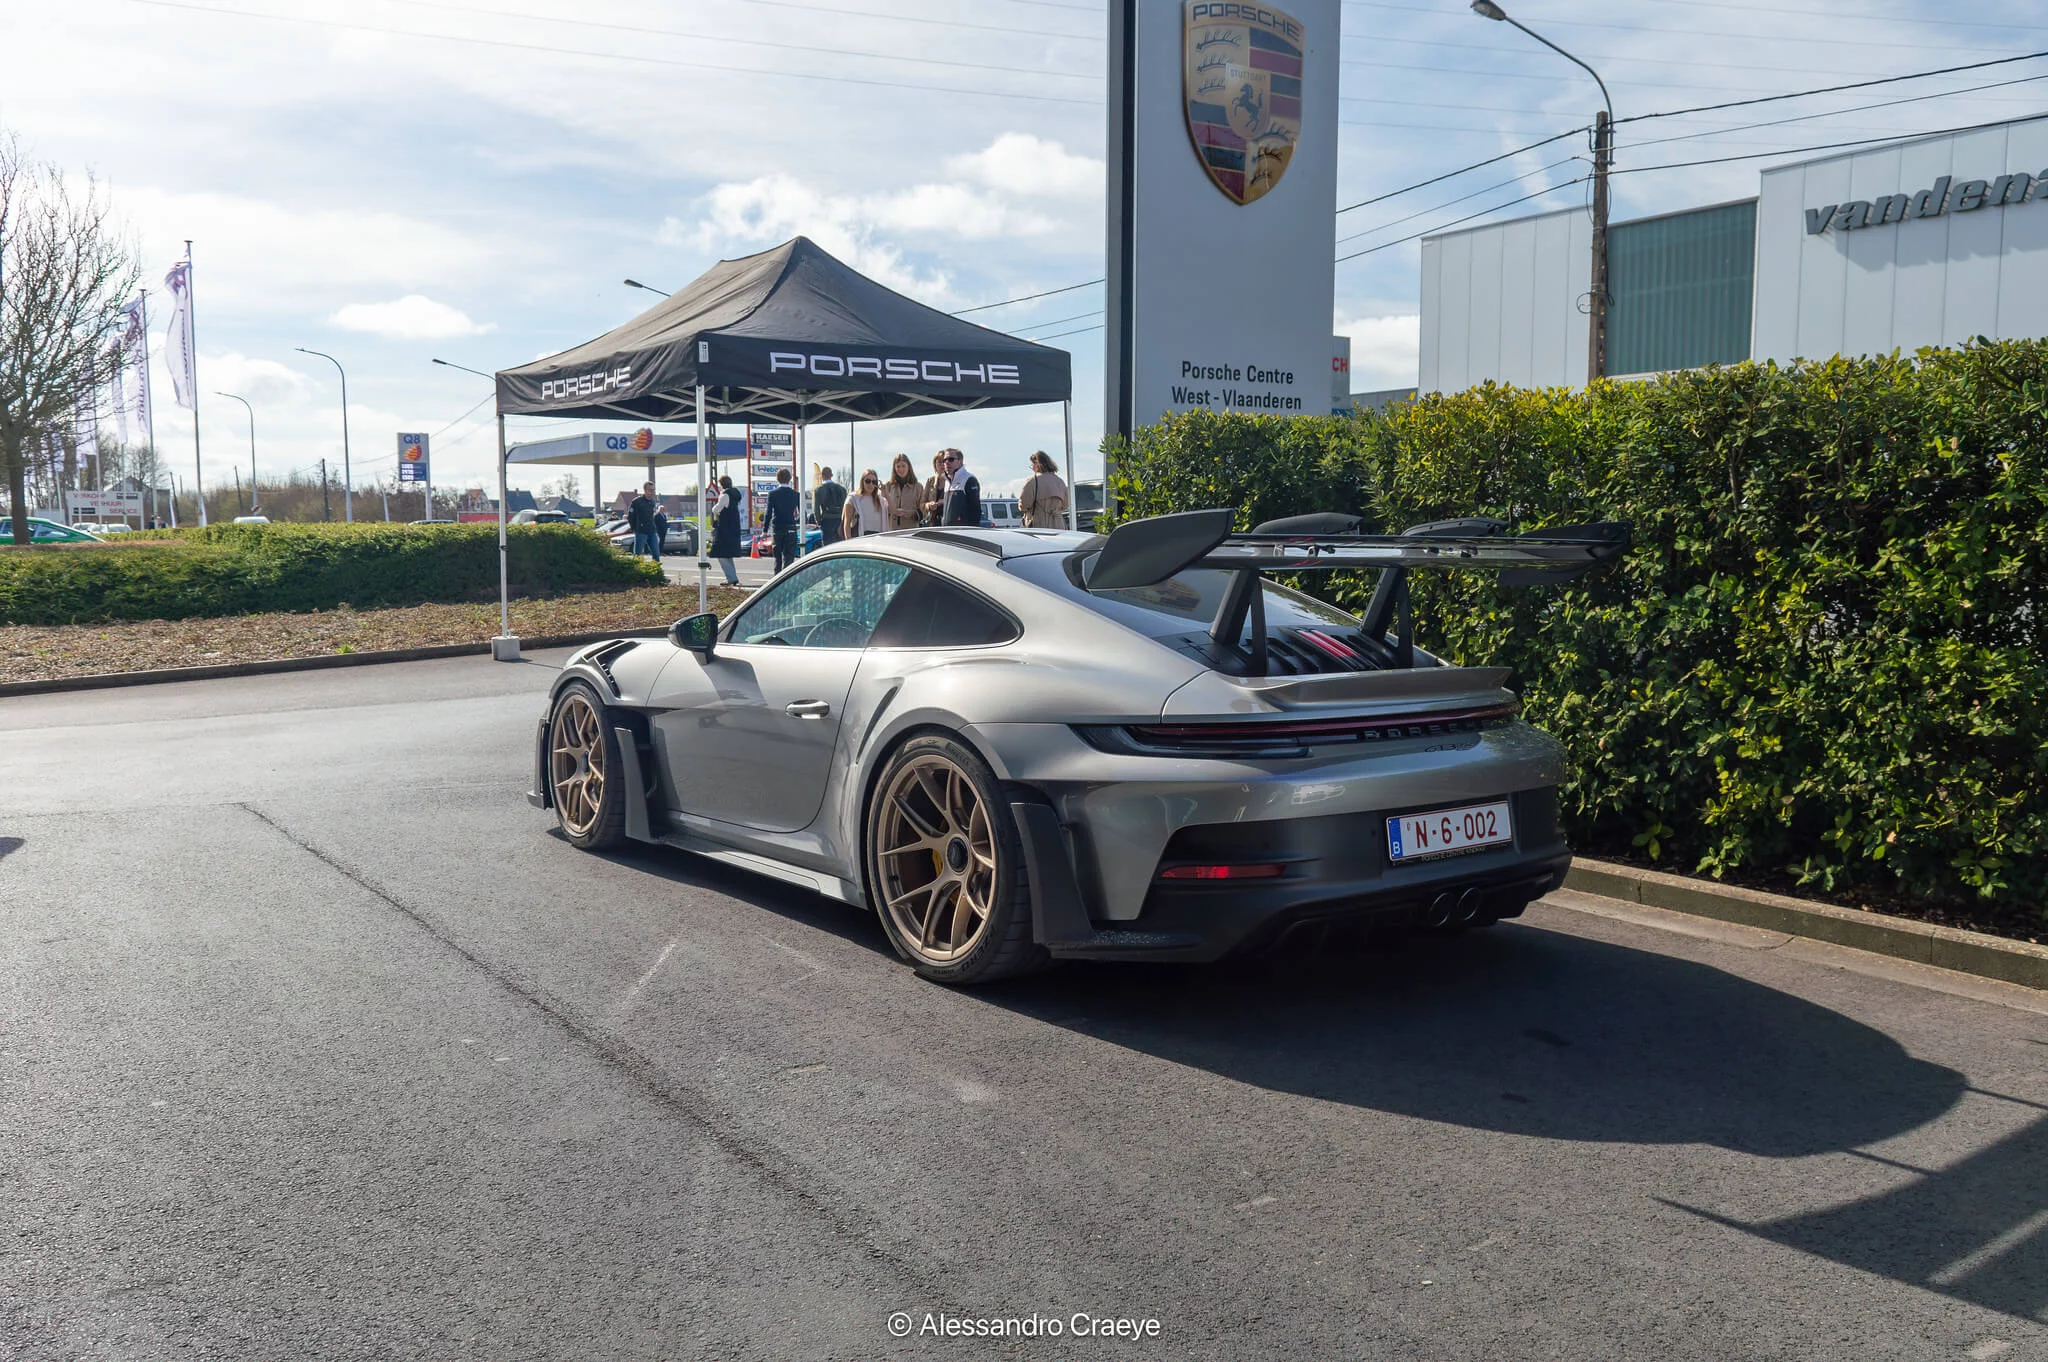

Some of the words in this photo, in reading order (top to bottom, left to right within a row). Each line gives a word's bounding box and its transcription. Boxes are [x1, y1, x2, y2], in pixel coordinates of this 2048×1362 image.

[1193, 3, 1301, 43] PORSCHE
[769, 351, 1020, 386] PORSCHE
[1182, 360, 1241, 381] Porsche
[1247, 365, 1294, 385] Centre
[541, 366, 632, 400] PORSCHE
[403, 434, 421, 445] Q8
[606, 436, 628, 450] Q8
[1392, 841, 1401, 855] B
